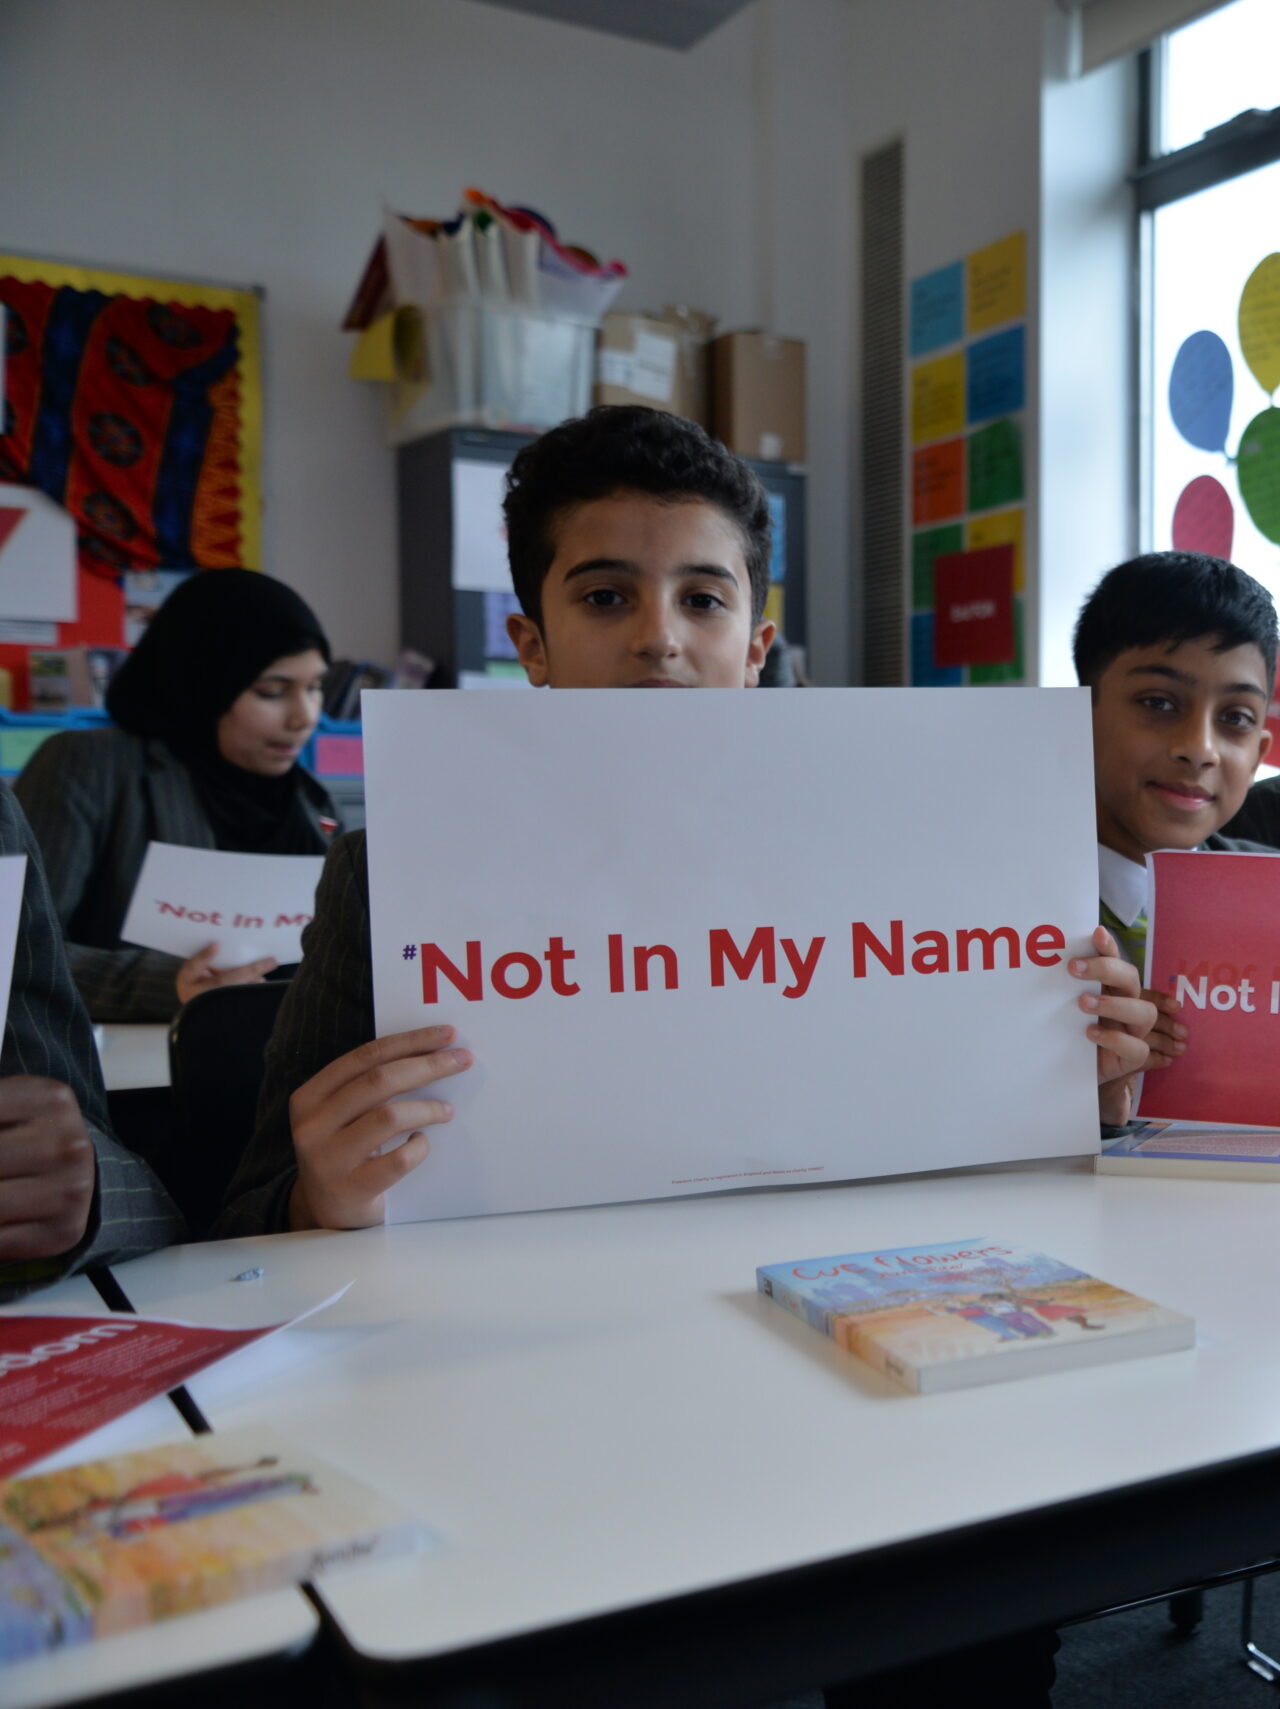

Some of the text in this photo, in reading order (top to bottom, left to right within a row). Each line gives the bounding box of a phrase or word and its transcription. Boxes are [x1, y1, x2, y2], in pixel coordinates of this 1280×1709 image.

[231, 914, 264, 929] In
[607, 933, 679, 994] In
[708, 926, 826, 1000] My
[851, 919, 1066, 979] Name
[1175, 974, 1256, 1013] Not
